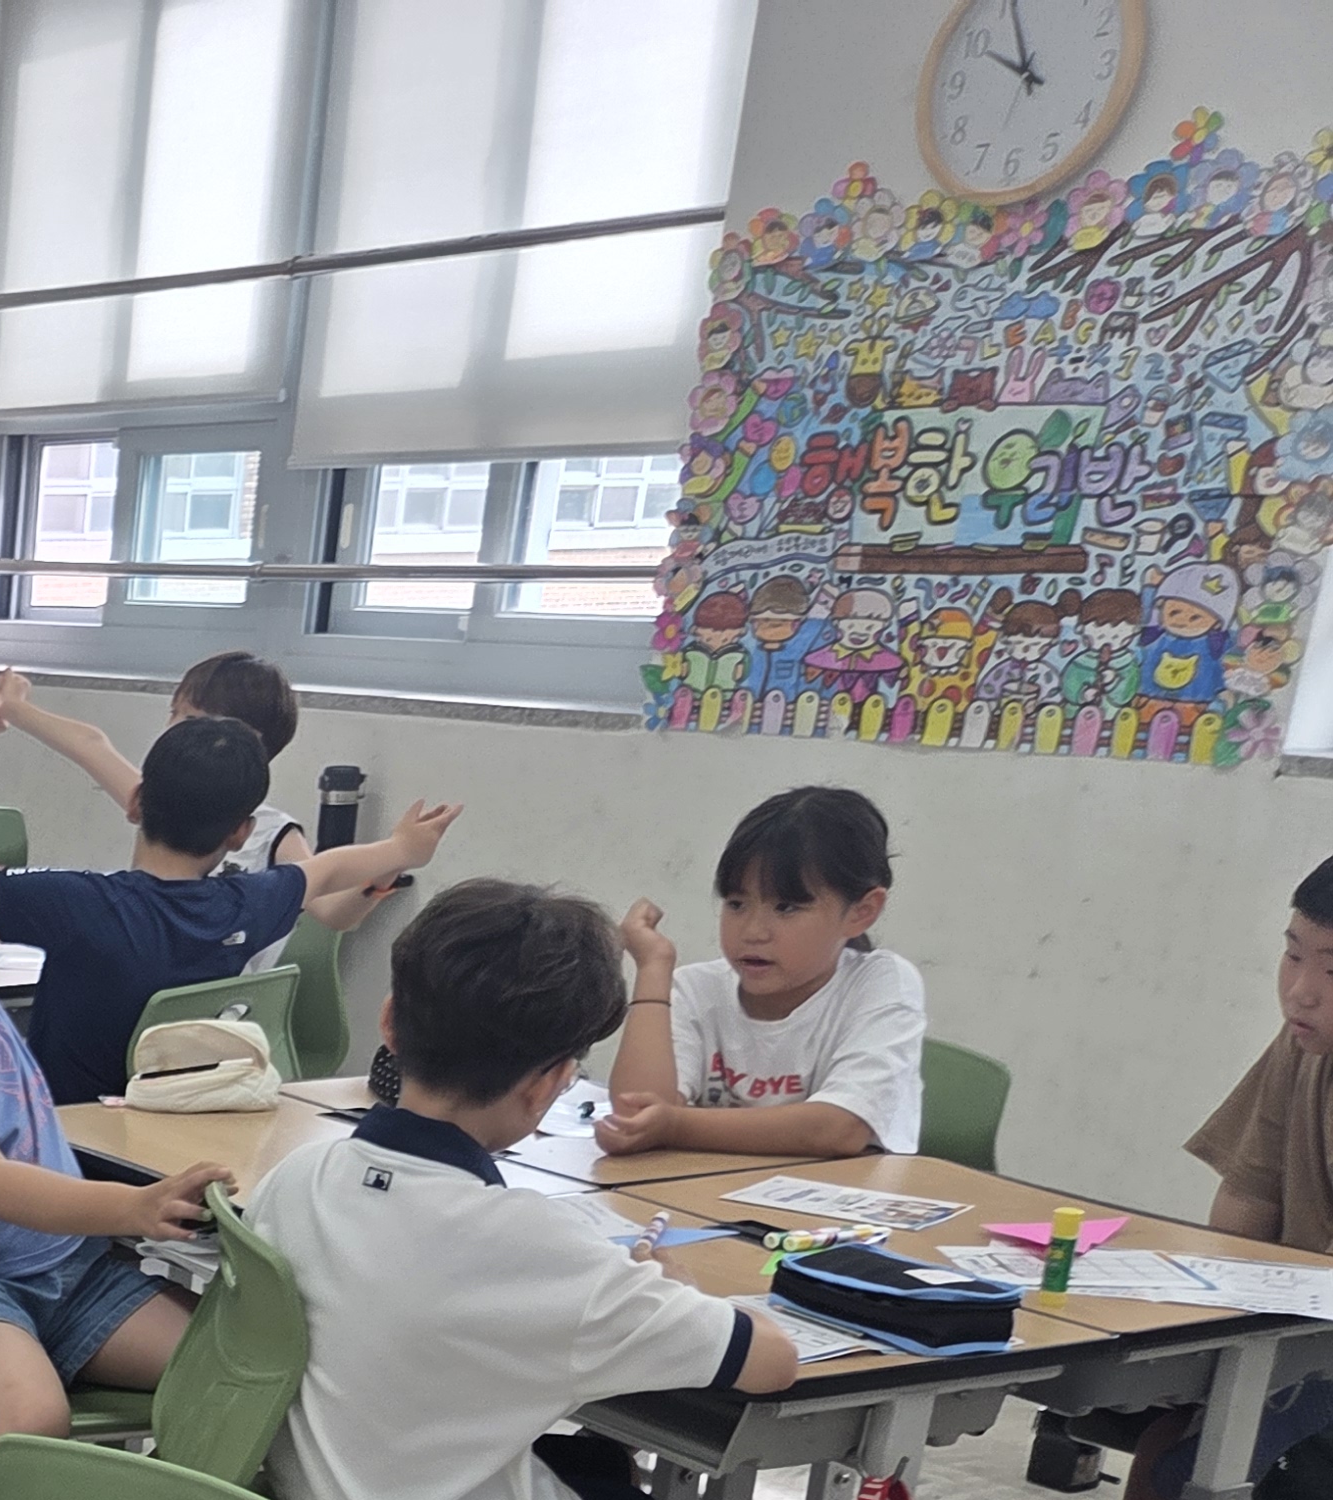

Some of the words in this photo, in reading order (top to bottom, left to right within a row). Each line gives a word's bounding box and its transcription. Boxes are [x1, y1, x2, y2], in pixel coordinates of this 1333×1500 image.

[1093, 6, 1116, 38] 2
[963, 28, 991, 59] 10
[1093, 48, 1118, 81] 3
[947, 70, 967, 101] 9
[1072, 99, 1093, 127] 4
[949, 115, 970, 145] 8
[972, 143, 992, 174] 7
[1002, 148, 1023, 178] 6
[1038, 132, 1061, 163] 5
[747, 1074, 804, 1099] BYE
